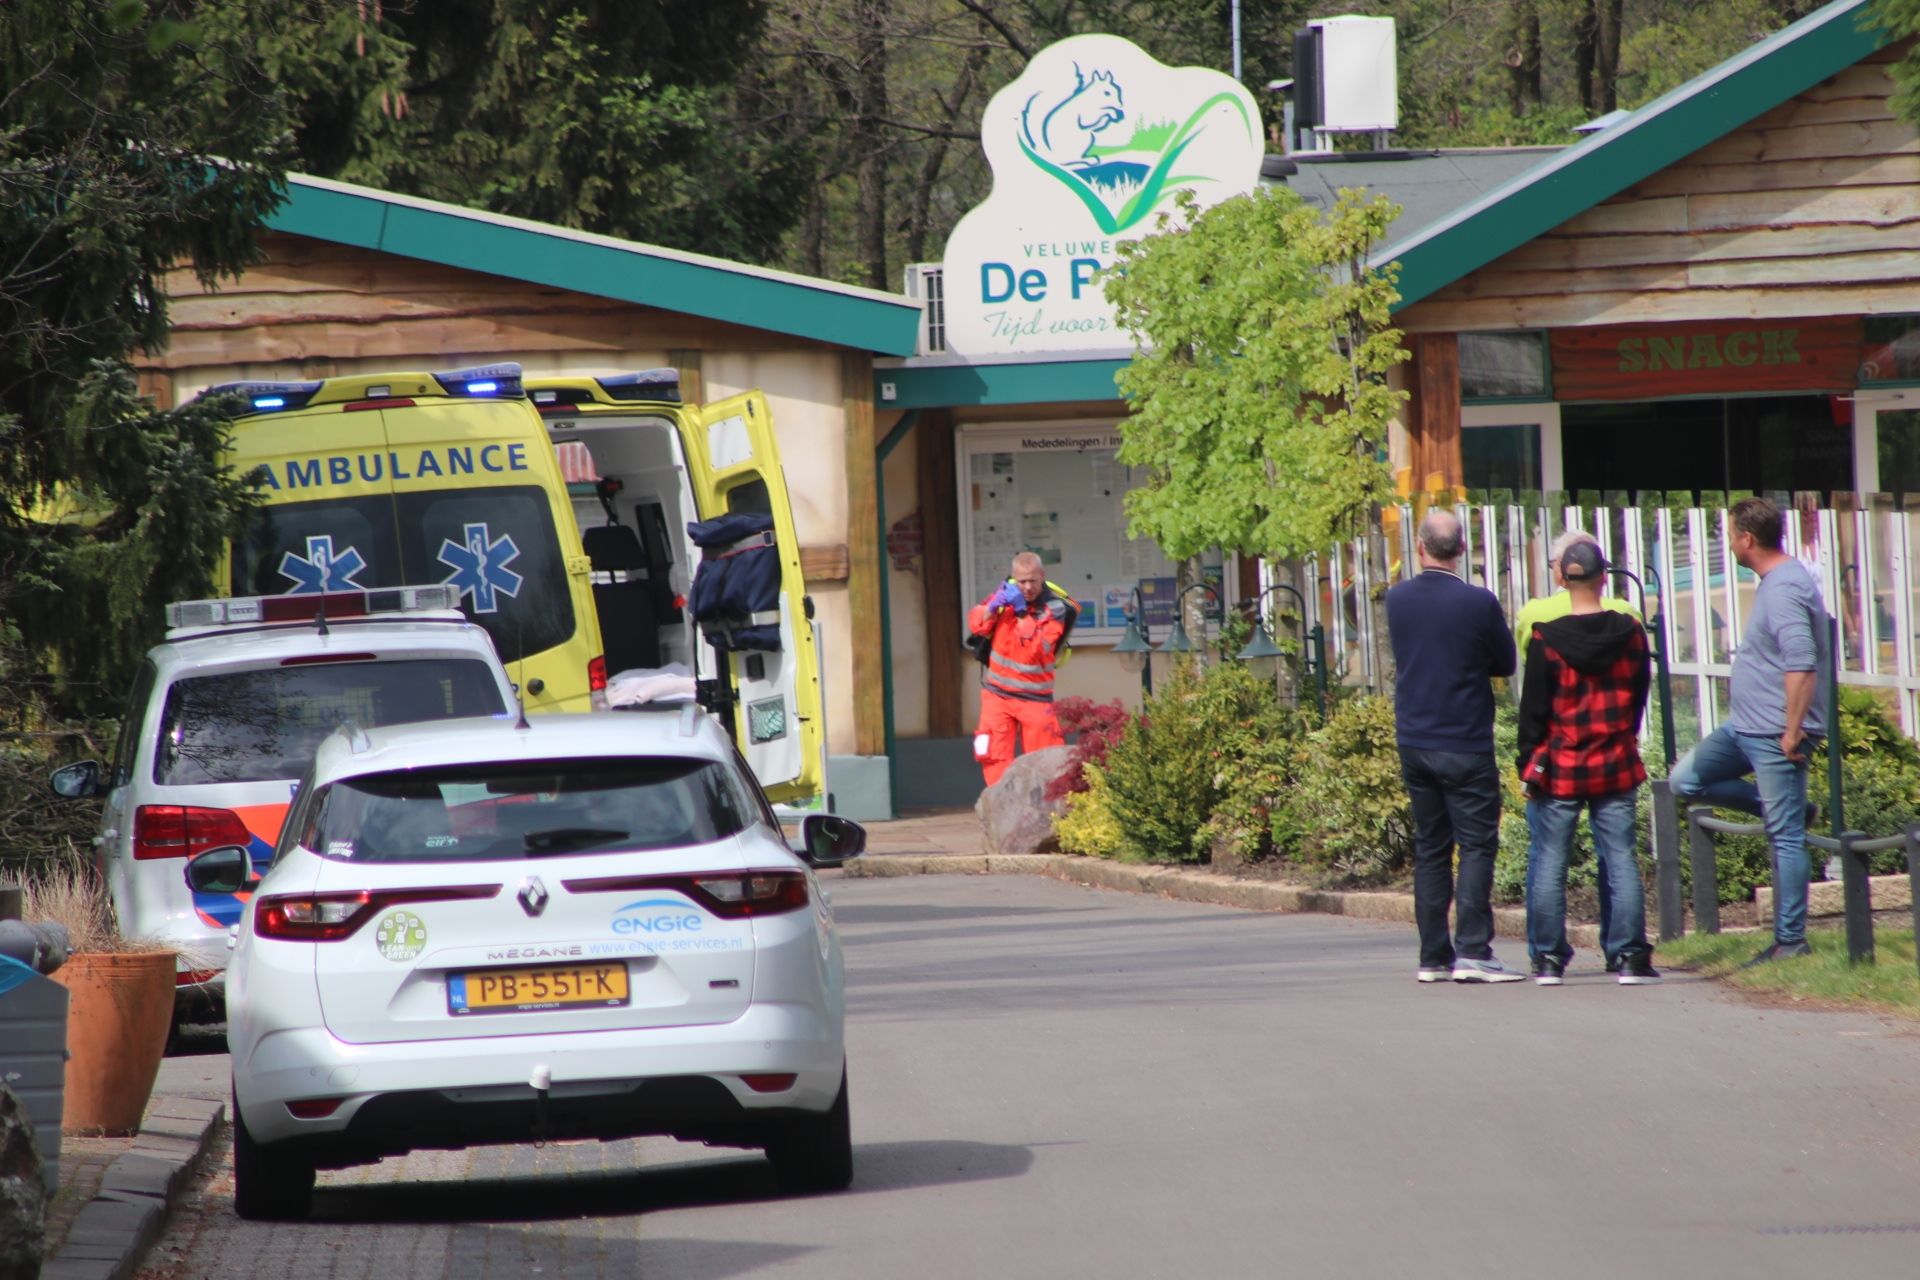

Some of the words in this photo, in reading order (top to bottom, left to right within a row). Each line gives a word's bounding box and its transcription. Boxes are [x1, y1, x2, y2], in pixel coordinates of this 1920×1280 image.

[1023, 240, 1122, 258] VELUWE
[981, 262, 1047, 303] De
[1070, 258, 1112, 299] P
[983, 308, 1043, 345] Tijd
[1050, 316, 1110, 334] voor
[1617, 329, 1803, 372] SNACK
[1021, 436, 1100, 449] Mededelingen
[253, 443, 529, 492] AMBULANCE
[381, 944, 404, 952] LEAN
[487, 946, 582, 960] MEGANE
[589, 937, 744, 954] www.engie-services.nl
[479, 968, 616, 1003] PB-551-K
[452, 994, 465, 1005] NL
[518, 1002, 560, 1010] engie-services.nl
